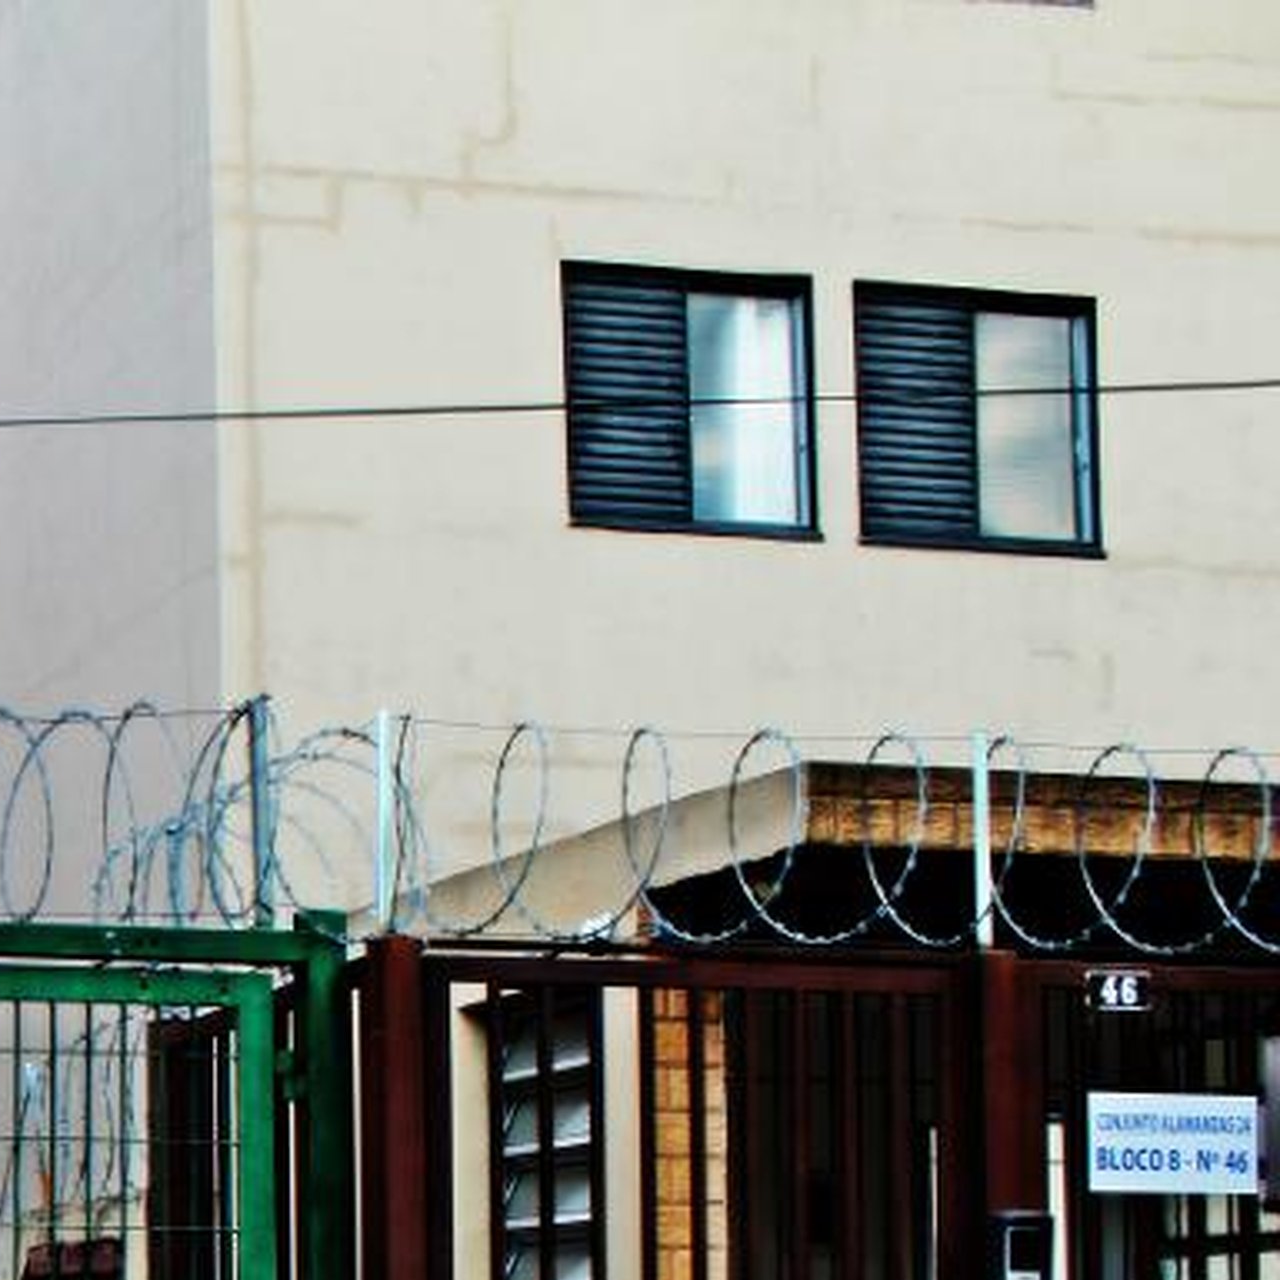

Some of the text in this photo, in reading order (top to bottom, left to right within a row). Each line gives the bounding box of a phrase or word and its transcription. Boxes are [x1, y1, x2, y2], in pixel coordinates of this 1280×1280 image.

[1099, 974, 1138, 1005] 46
[1096, 1146, 1164, 1172] BLOCO
[1225, 1150, 1249, 1175] 46
